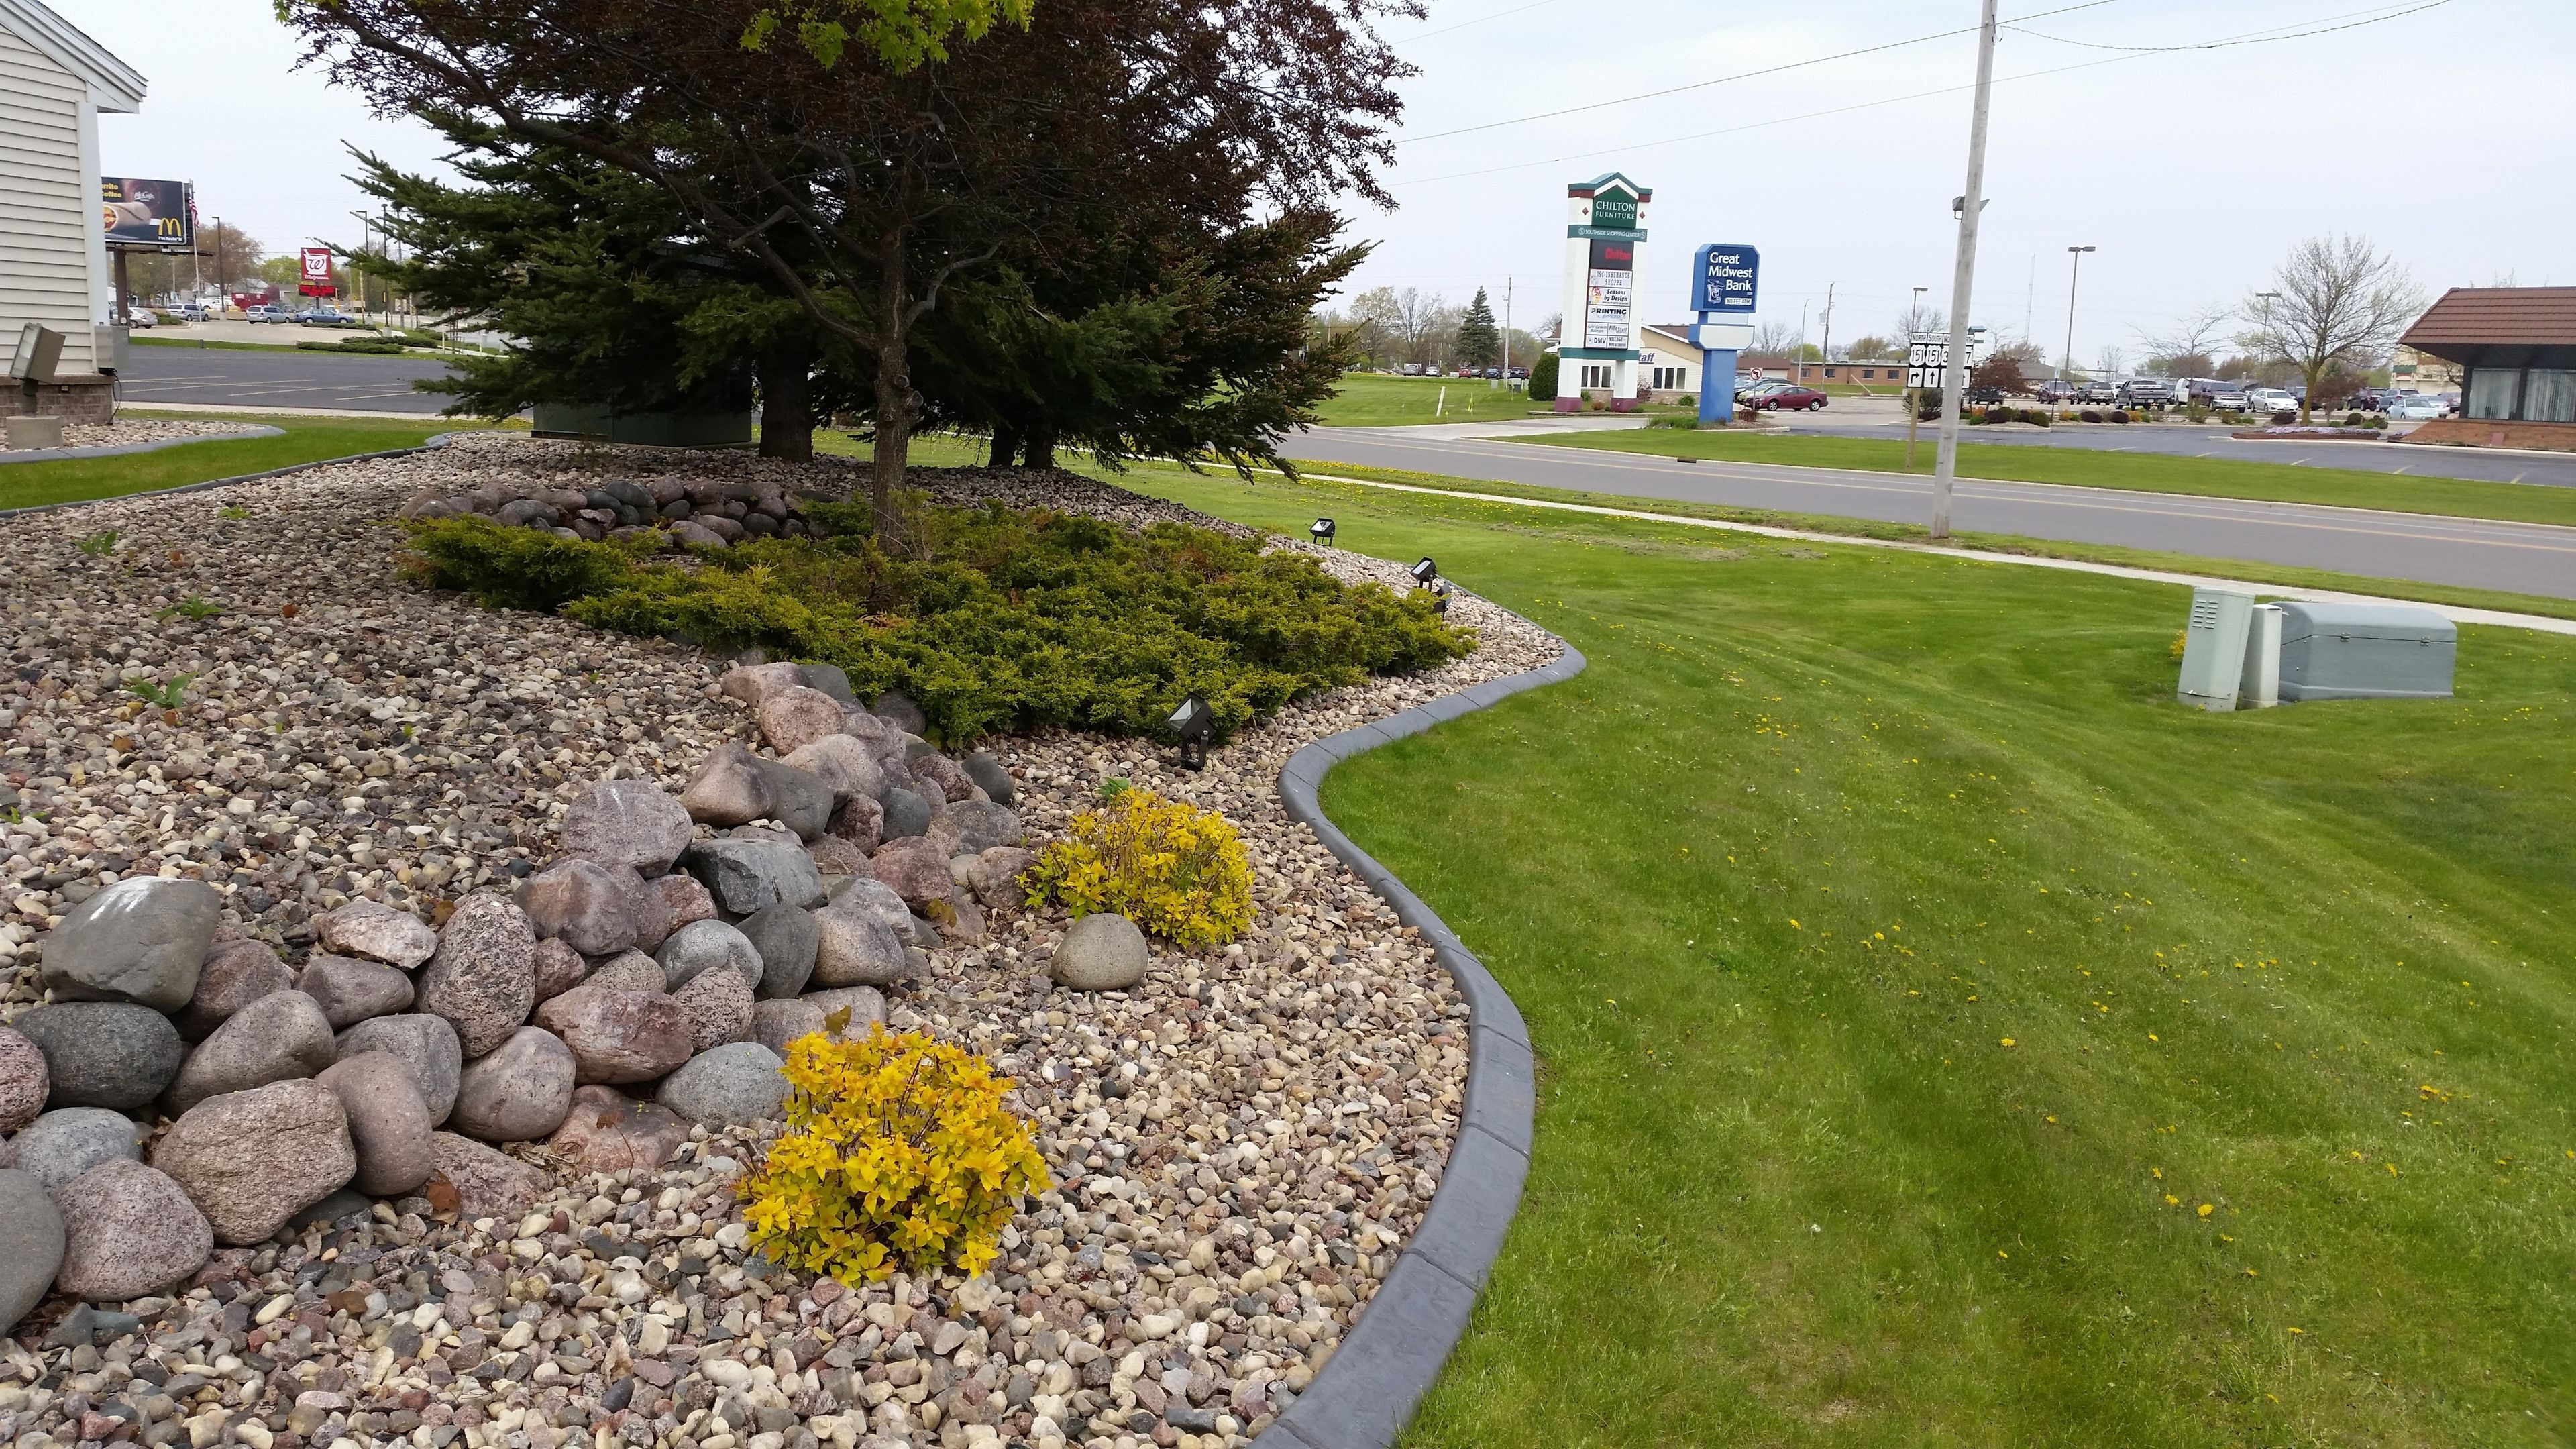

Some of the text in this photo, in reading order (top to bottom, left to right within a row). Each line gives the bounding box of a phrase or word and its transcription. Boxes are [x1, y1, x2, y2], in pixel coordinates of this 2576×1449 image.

[1596, 201, 1635, 211] CHILTON
[1595, 211, 1635, 219] FURNITURE
[1709, 252, 1740, 264] Great
[1597, 270, 1631, 279] ISC-INSURANCE
[1708, 265, 1753, 278] Midwest
[1725, 279, 1752, 291] Bank
[1929, 334, 1942, 342] SOUTH
[1639, 353, 1655, 362] taff
[1912, 349, 1924, 362] 151
[1927, 350, 1940, 362] 151
[1943, 351, 1949, 363] 3
[1966, 351, 1972, 364] 7
